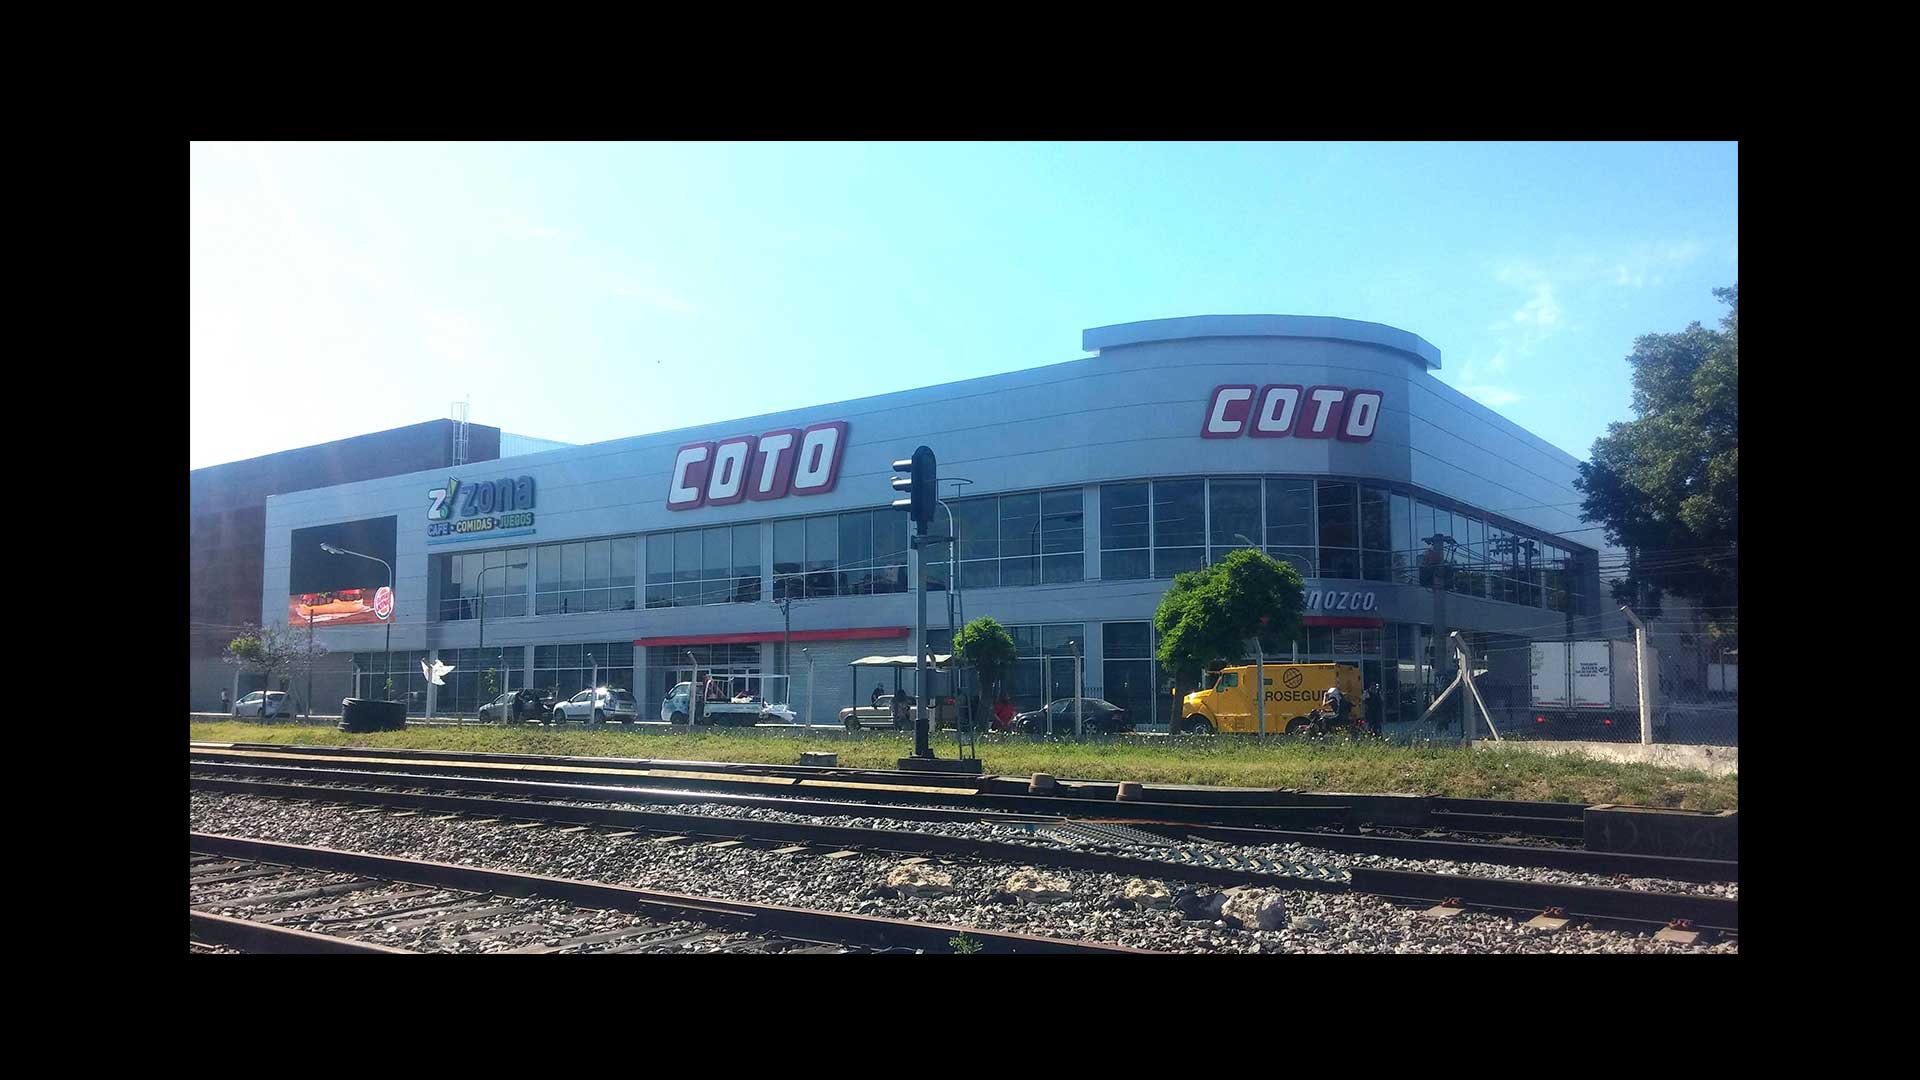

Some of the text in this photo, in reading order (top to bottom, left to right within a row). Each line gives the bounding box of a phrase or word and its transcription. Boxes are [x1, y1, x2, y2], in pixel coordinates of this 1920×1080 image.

[1208, 387, 1382, 438] COTO
[668, 427, 839, 504] COTO
[460, 476, 536, 518] zona
[456, 517, 494, 534] COMIDAS
[500, 512, 534, 529] JUEGOS
[1256, 690, 1330, 702] ROSEGU
